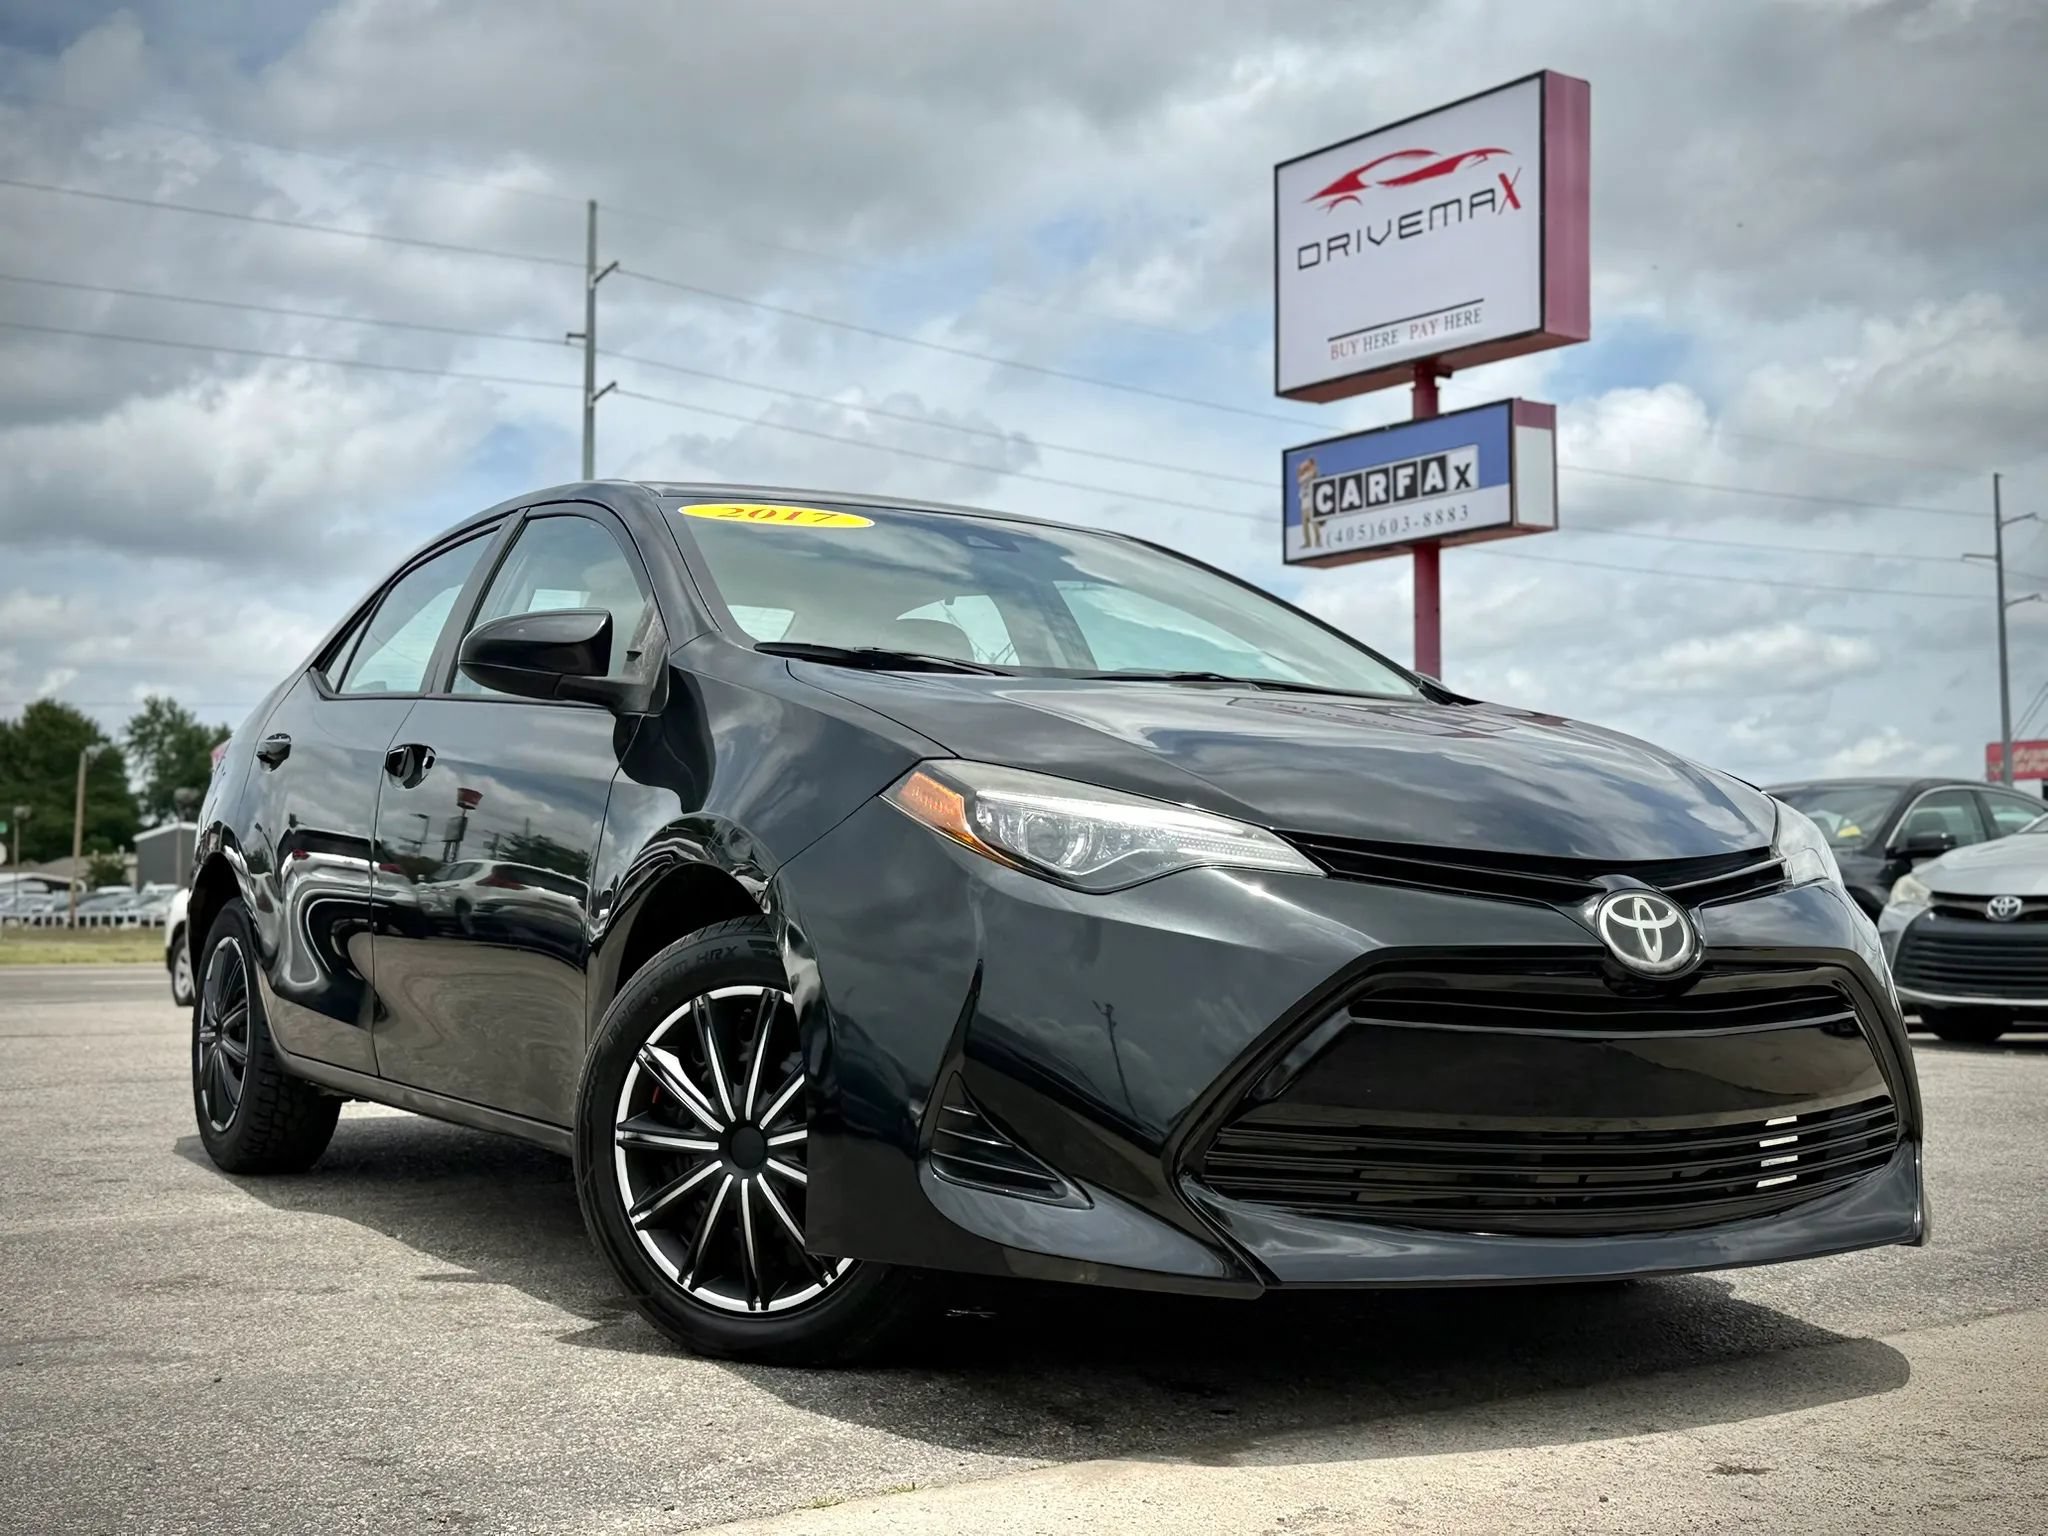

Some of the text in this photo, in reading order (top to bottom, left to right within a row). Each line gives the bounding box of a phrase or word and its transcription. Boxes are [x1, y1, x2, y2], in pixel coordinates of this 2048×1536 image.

[1298, 167, 1522, 271] DRIVEMAX
[1330, 307, 1483, 361] BUY HERE PAY HERE
[1314, 454, 1473, 515] CARFAX
[717, 507, 839, 523] 2017
